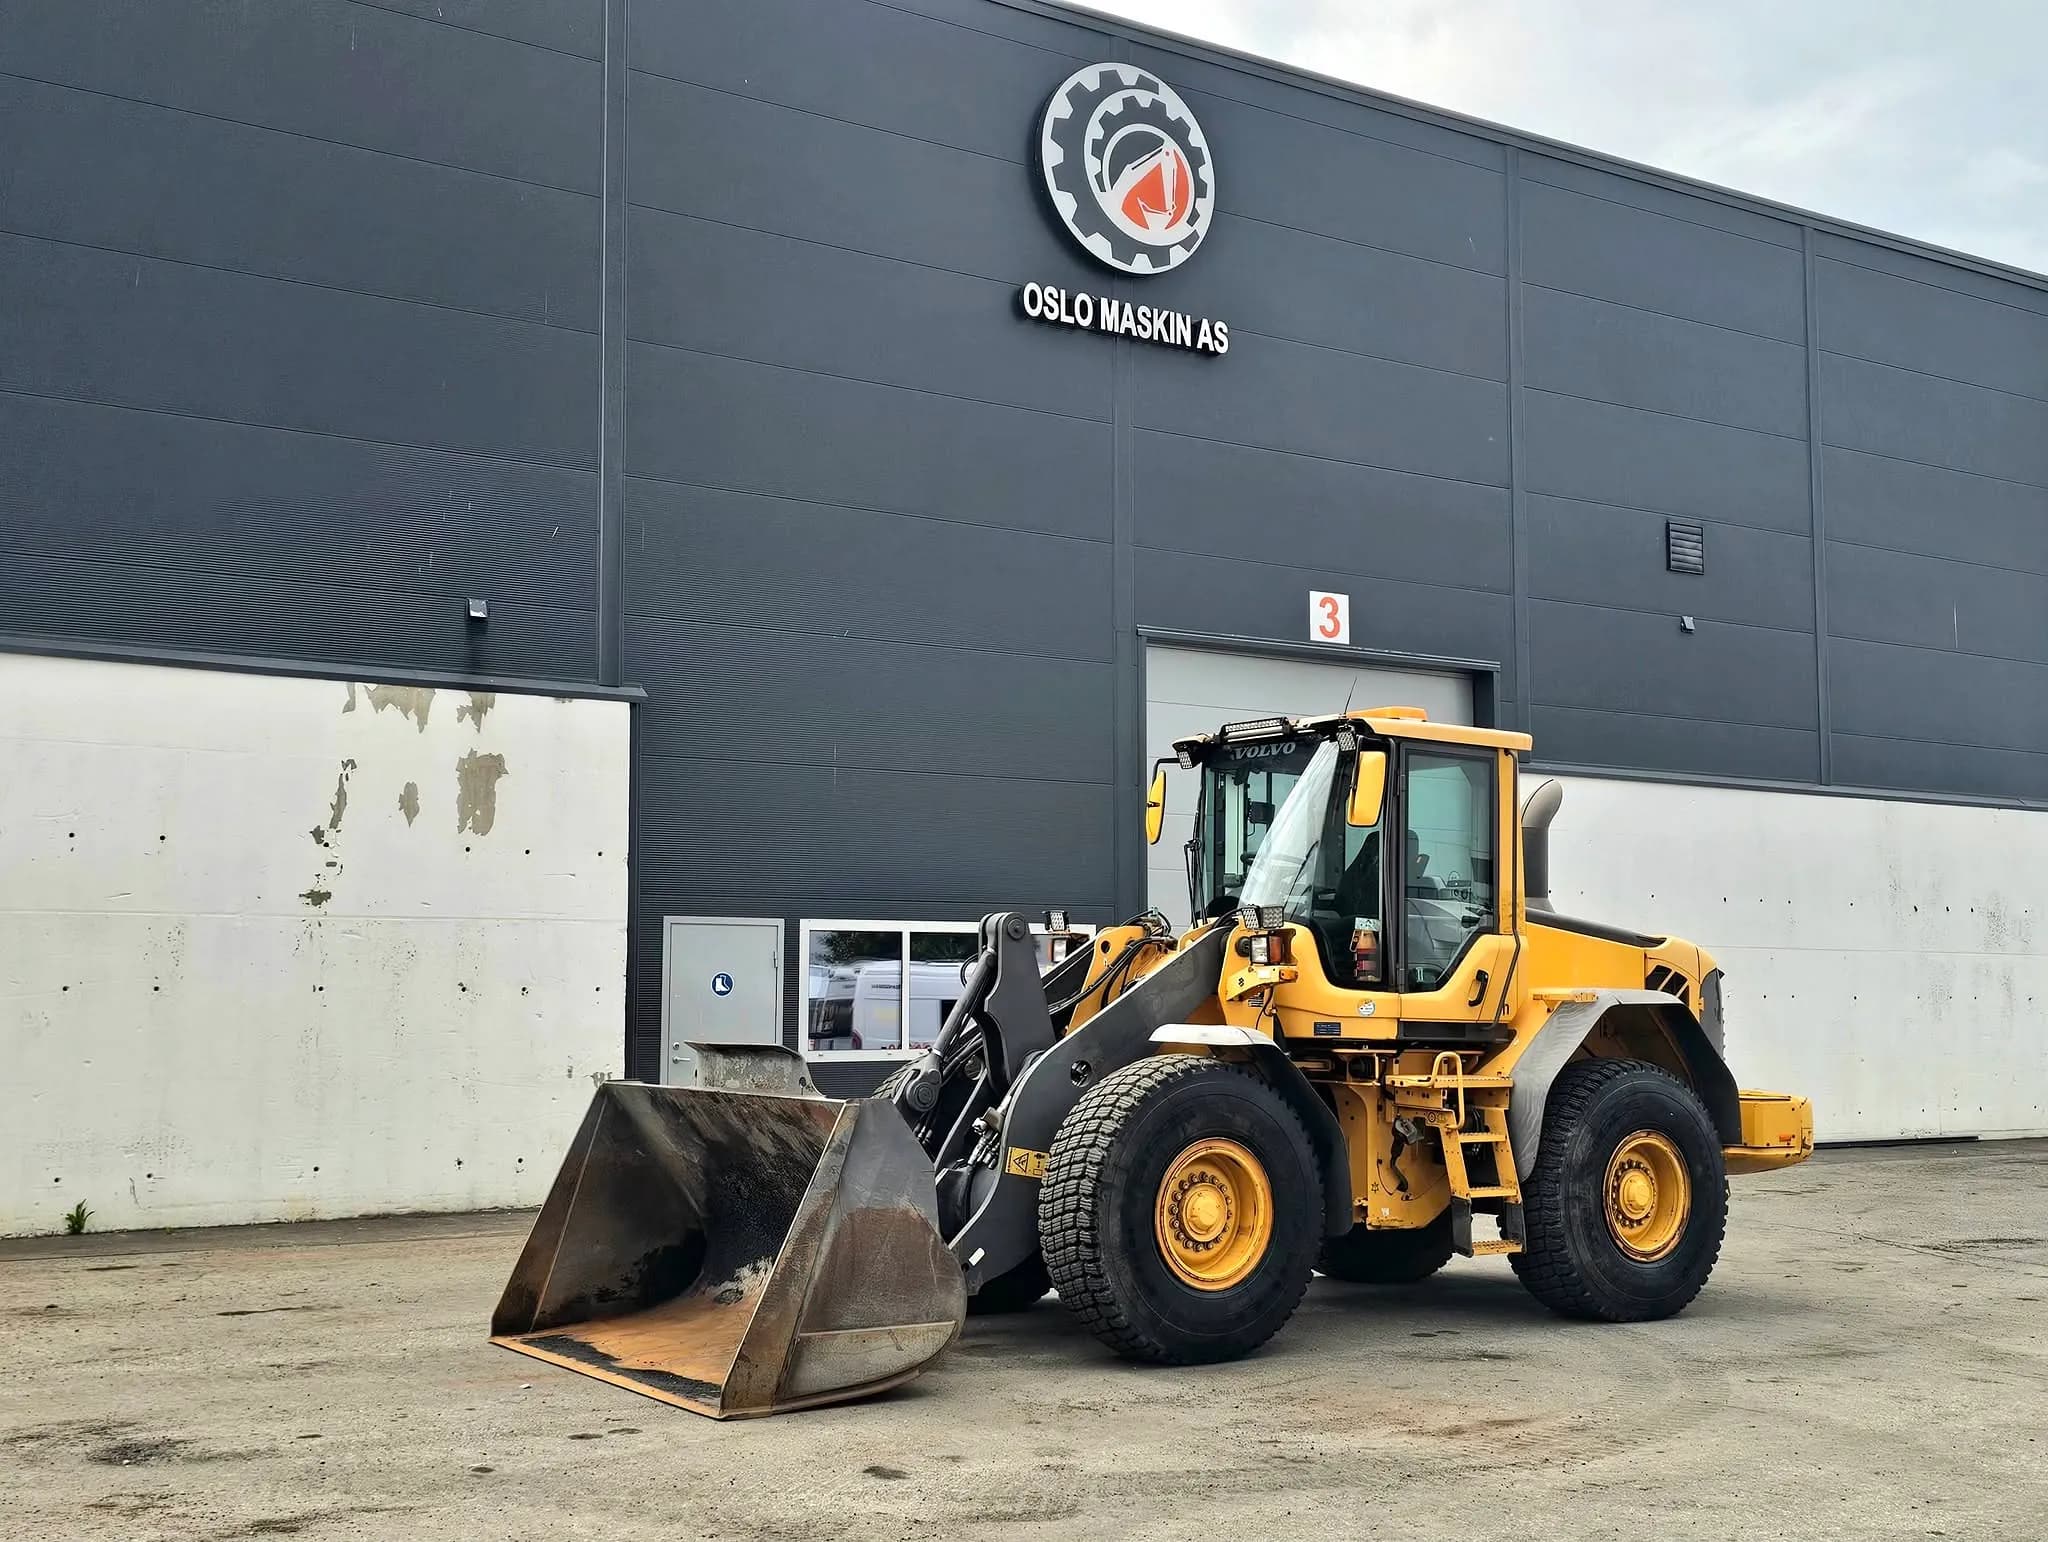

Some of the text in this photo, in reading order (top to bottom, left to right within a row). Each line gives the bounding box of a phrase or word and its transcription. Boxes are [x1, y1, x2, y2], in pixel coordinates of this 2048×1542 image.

[1023, 282, 1229, 354] OSLO MASKIN AS
[1319, 596, 1340, 638] 3
[1233, 742, 1296, 760] VOLVO
